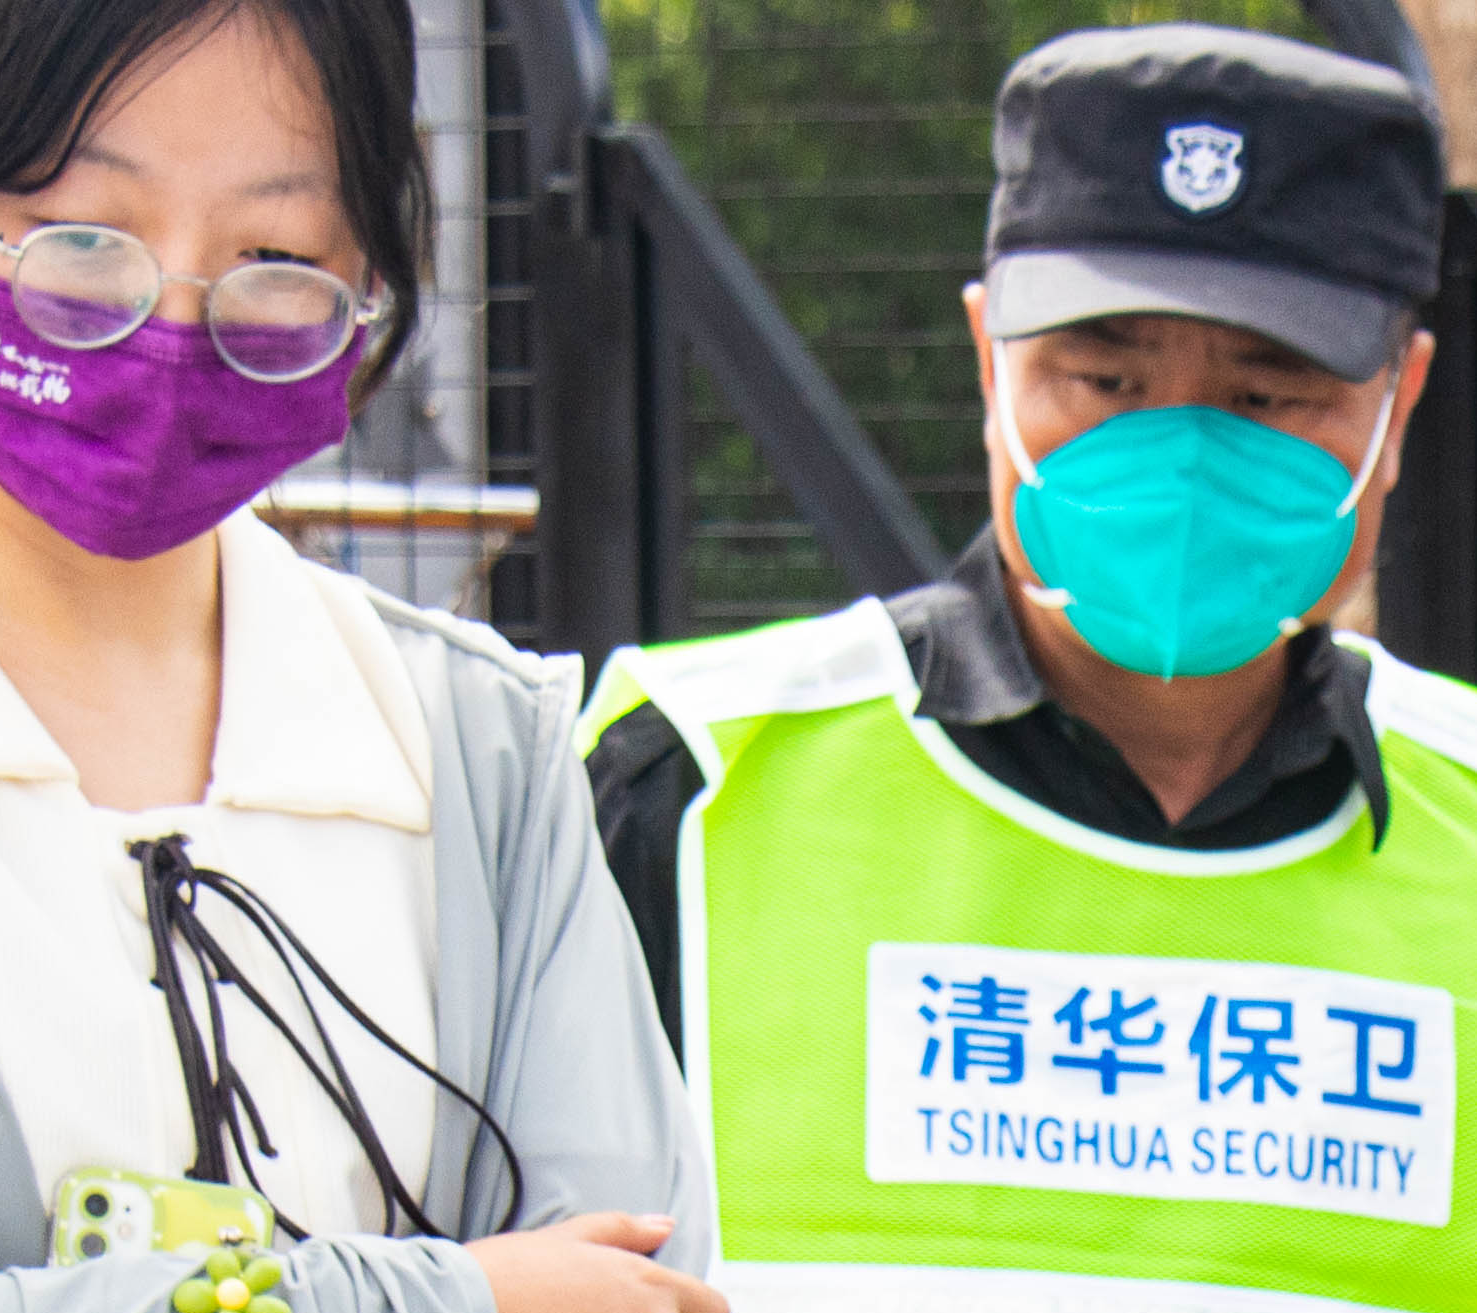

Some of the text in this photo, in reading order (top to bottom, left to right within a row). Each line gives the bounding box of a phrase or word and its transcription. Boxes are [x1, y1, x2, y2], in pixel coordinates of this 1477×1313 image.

[916, 973, 1425, 1119] 清华保卫
[917, 1108, 1418, 1195] TSINGHUA SECURITY
